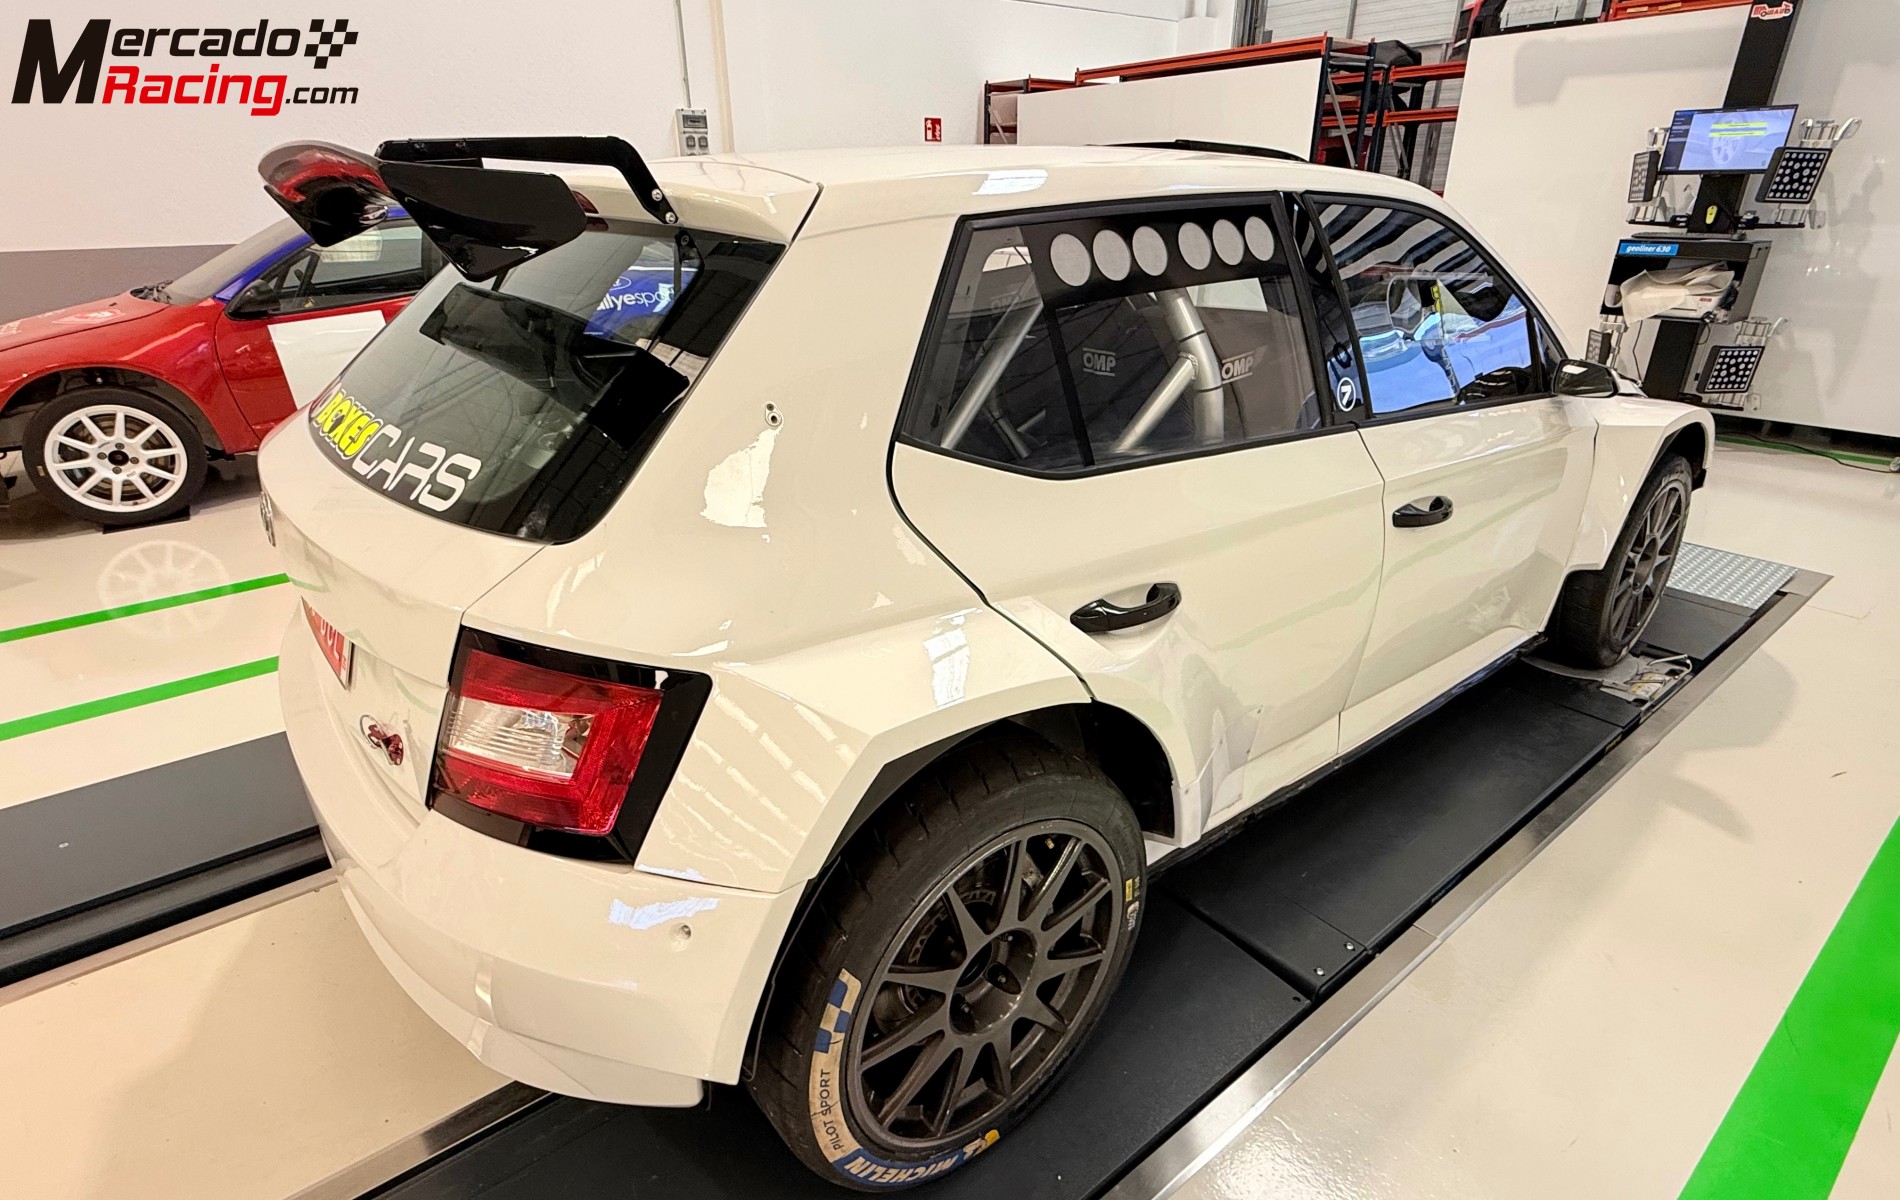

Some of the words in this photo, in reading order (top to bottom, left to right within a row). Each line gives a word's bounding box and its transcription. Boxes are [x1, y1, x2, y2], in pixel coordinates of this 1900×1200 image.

[1625, 244, 1656, 254] geoliner
[1656, 245, 1672, 253] 630
[1083, 352, 1117, 373] OMP
[1221, 355, 1254, 380] OMP
[1340, 384, 1352, 407] 7
[313, 389, 384, 460] BOXES
[352, 424, 482, 512] CARS
[820, 1069, 832, 1116] SPORT
[823, 1118, 845, 1151] PILOT
[844, 1154, 959, 1184] MICHELIN
